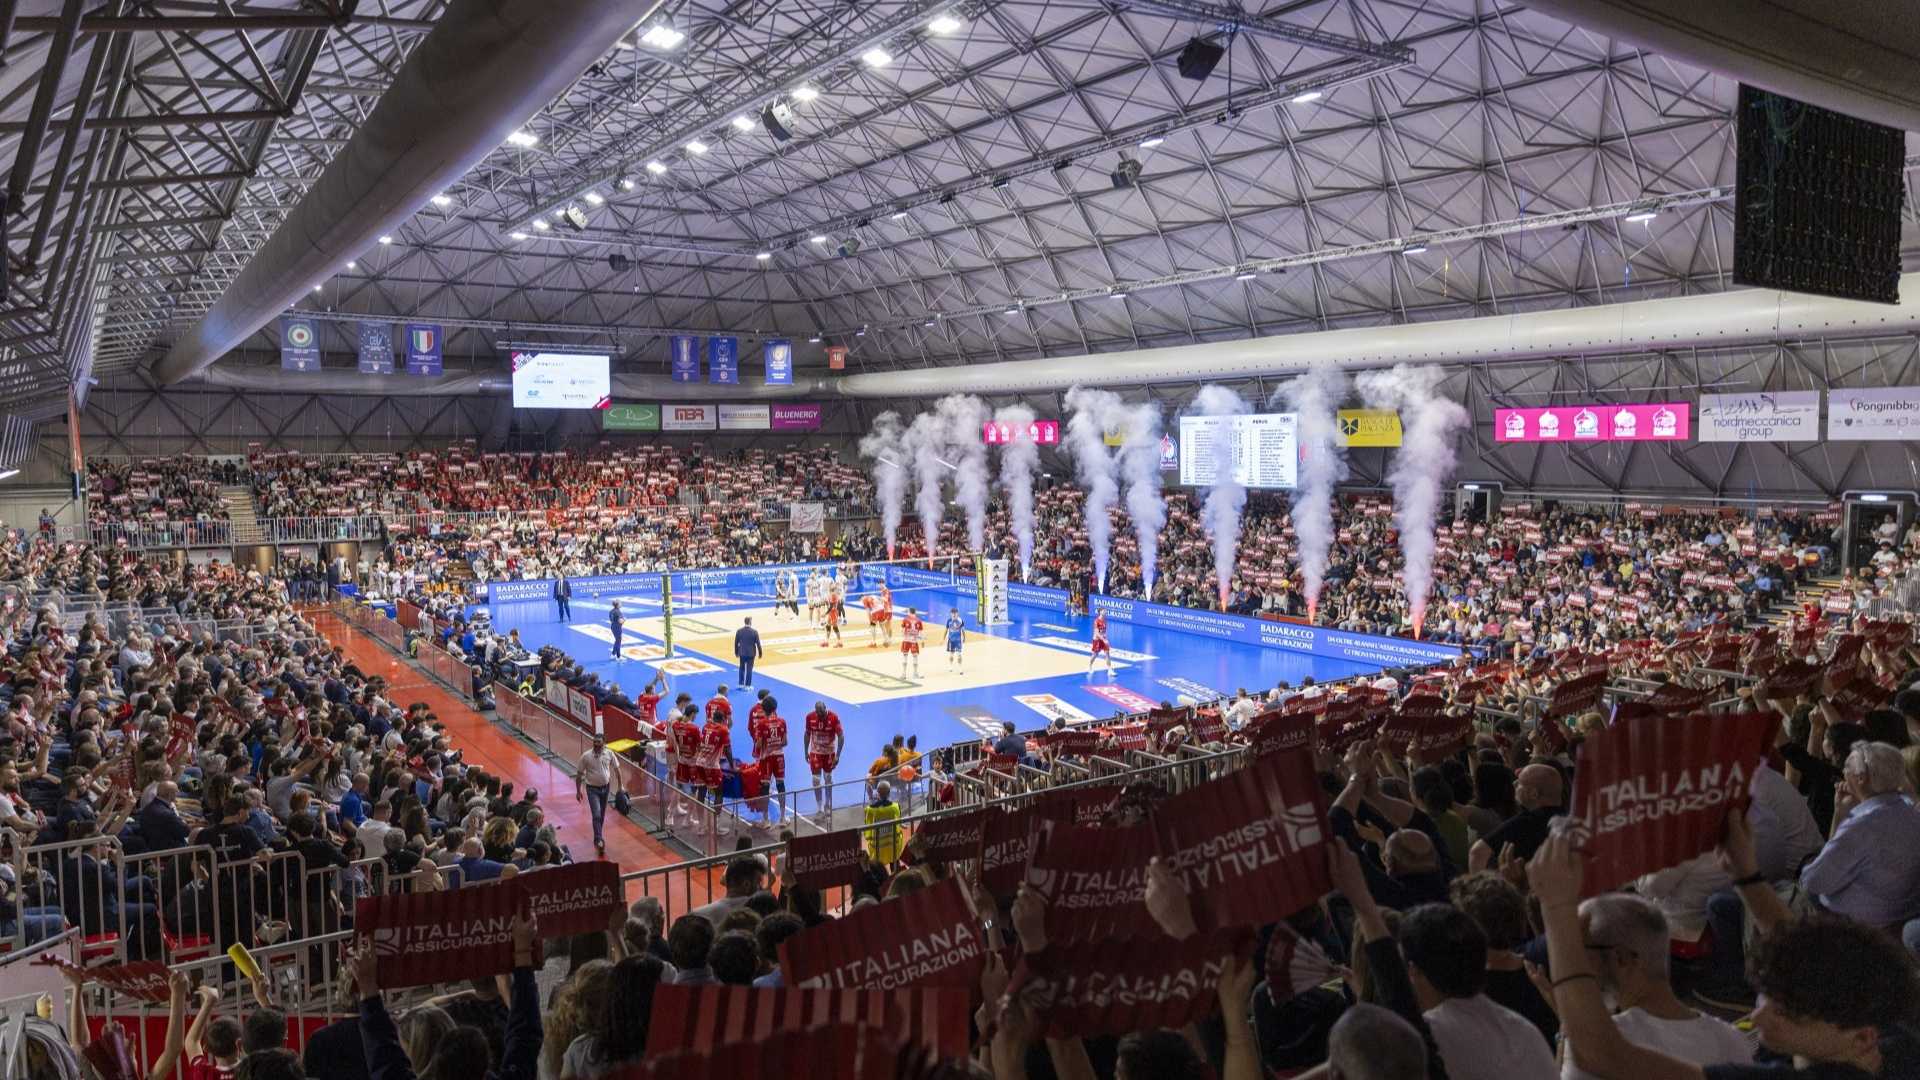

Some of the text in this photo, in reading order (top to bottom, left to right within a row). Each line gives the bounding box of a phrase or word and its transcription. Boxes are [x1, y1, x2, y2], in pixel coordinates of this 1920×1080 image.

[775, 410, 817, 419] BLUENERGY
[1714, 415, 1801, 427] nordmeccanica
[1739, 426, 1773, 440] group
[496, 583, 548, 593] BADARACCO
[498, 591, 548, 601] ASSICURAZIONI
[1094, 599, 1133, 611] BADARACCO
[1260, 624, 1314, 640] BADARACCO
[1261, 636, 1313, 650] ASSICURAZIONI
[1376, 653, 1398, 662] PIAZZA
[770, 728, 778, 738] 21
[1600, 760, 1744, 811] TALIANA
[1168, 815, 1280, 873] ASSICURAZIO
[809, 850, 858, 865] ITALIAN
[1183, 836, 1284, 894] ITALIA
[1061, 867, 1147, 892] ITALIA
[528, 885, 612, 907] TALIANA
[1055, 887, 1145, 909] ASSICURAZ
[530, 896, 612, 914] SICURAZIONI
[404, 931, 512, 954] ASSICURAZIO
[835, 922, 974, 989] ITALIANA
[856, 942, 978, 991] SICURAZIONI
